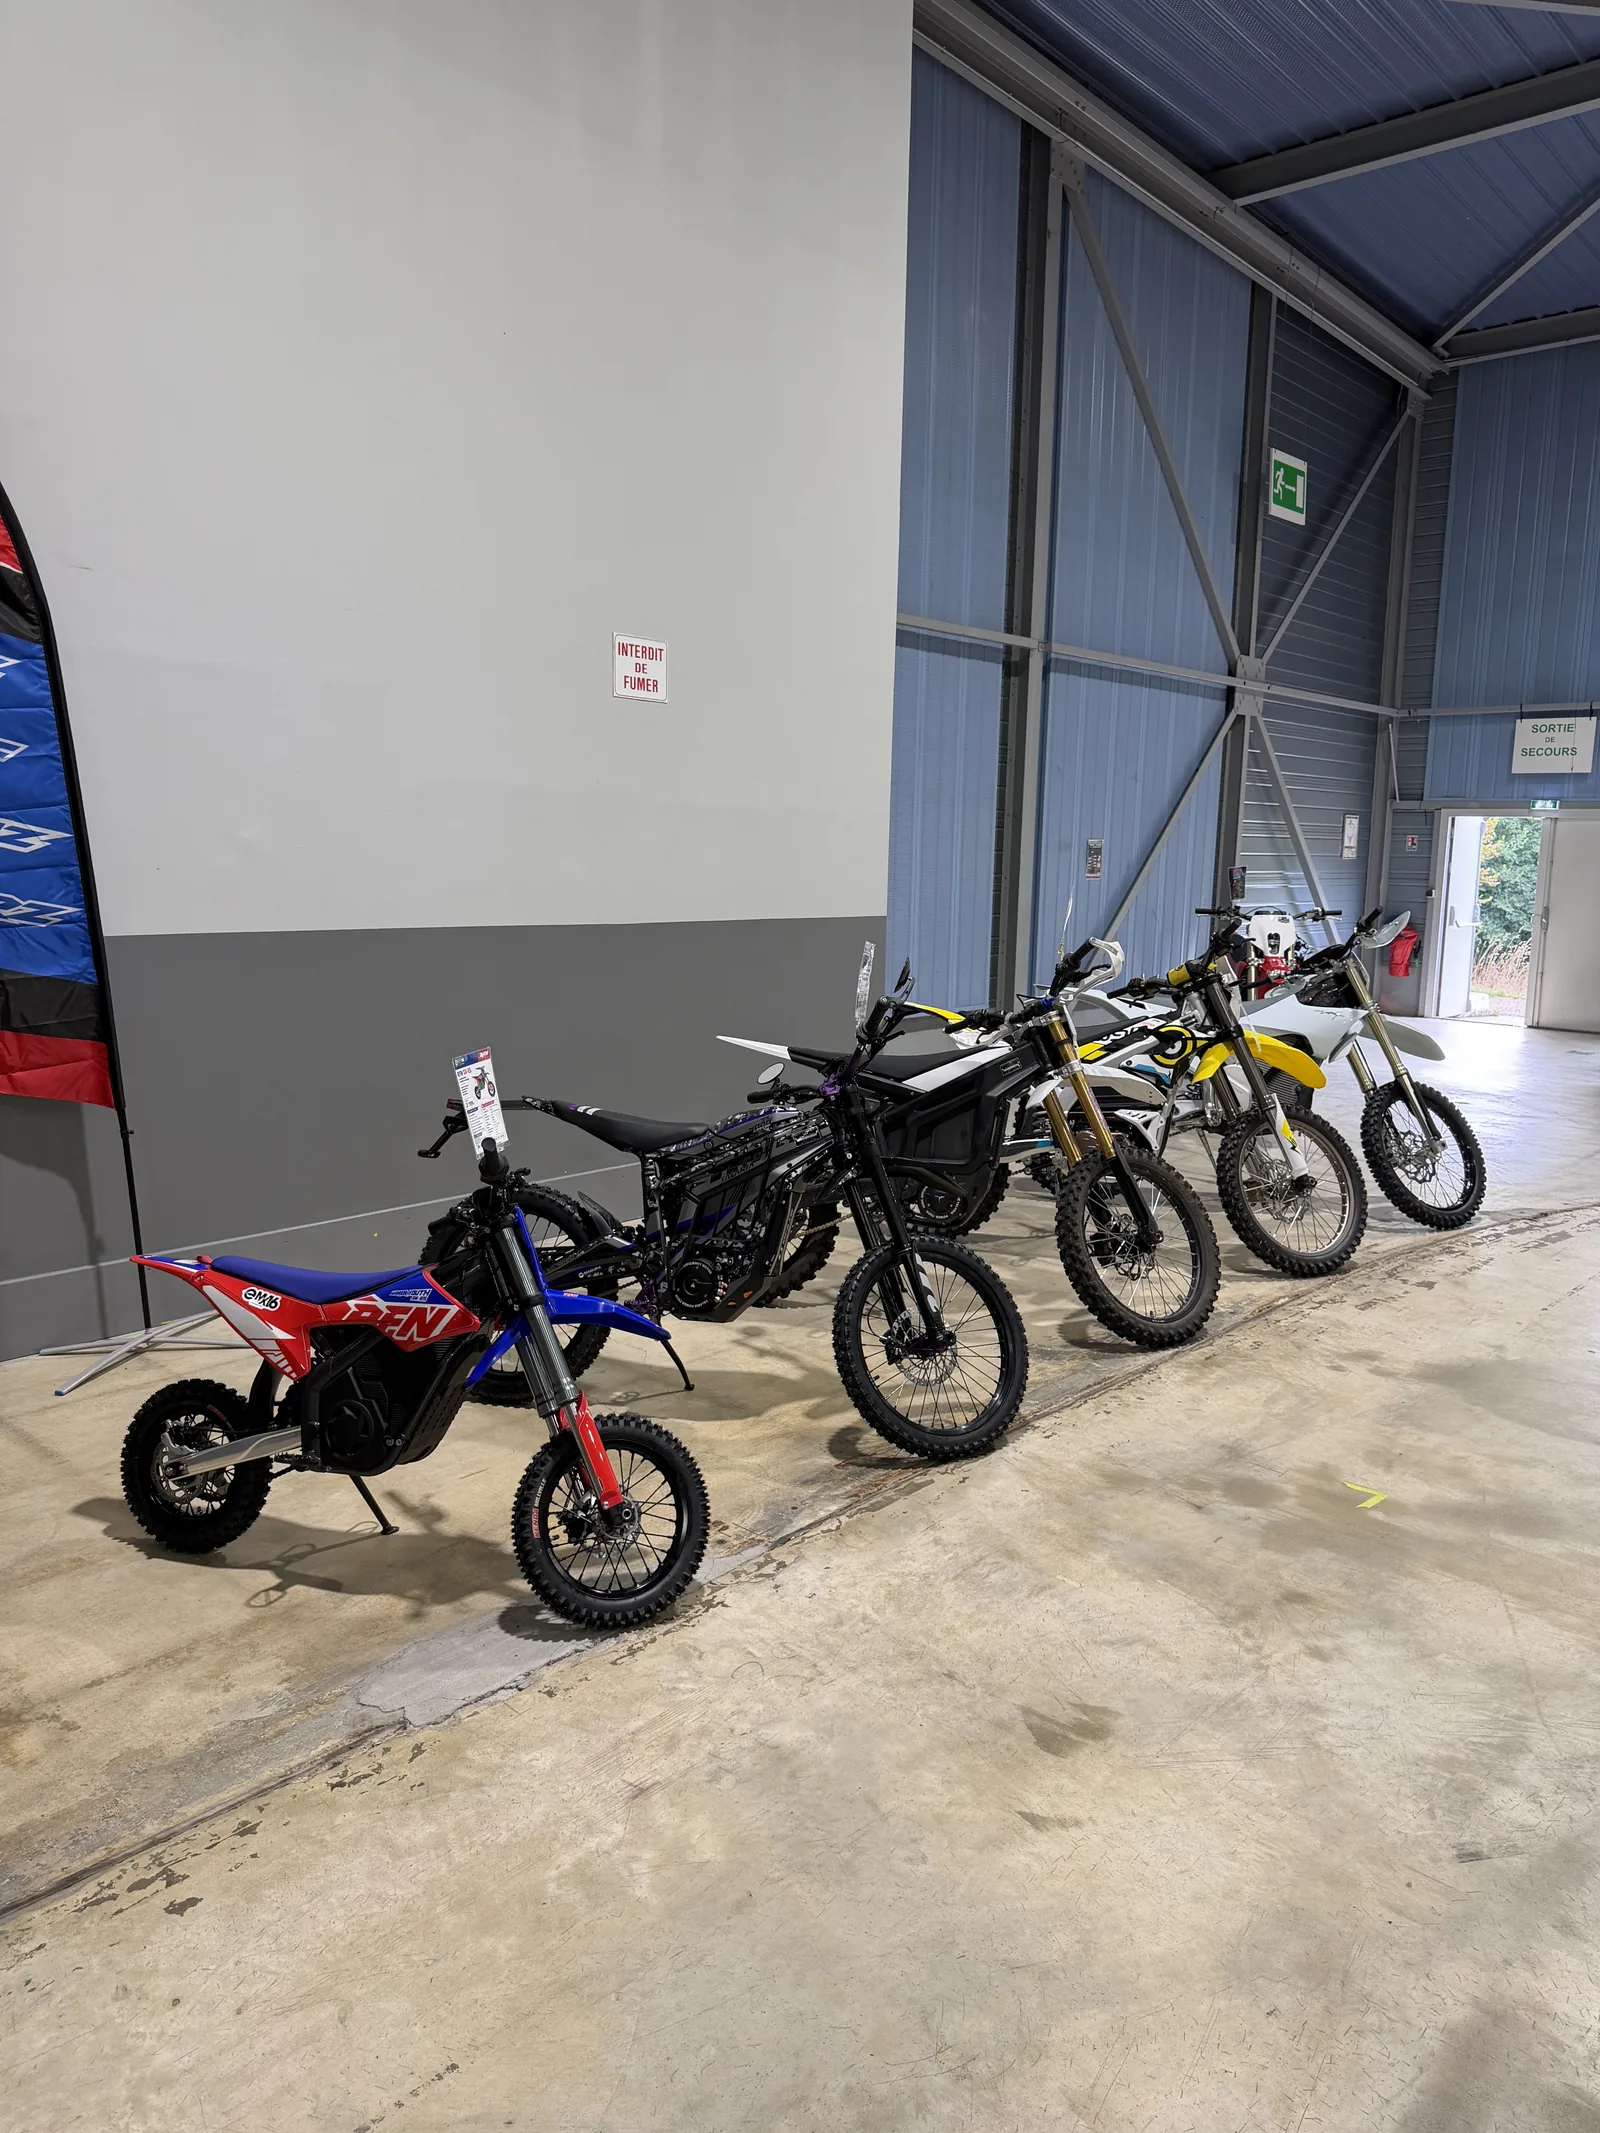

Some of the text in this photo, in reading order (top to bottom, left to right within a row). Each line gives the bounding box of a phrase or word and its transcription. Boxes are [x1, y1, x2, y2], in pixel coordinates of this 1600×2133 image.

[617, 641, 664, 662] INTERDIT
[634, 662, 648, 674] DE
[623, 675, 659, 693] FUMER
[1531, 723, 1574, 733] SORTIE
[1520, 747, 1578, 757] SECOURS
